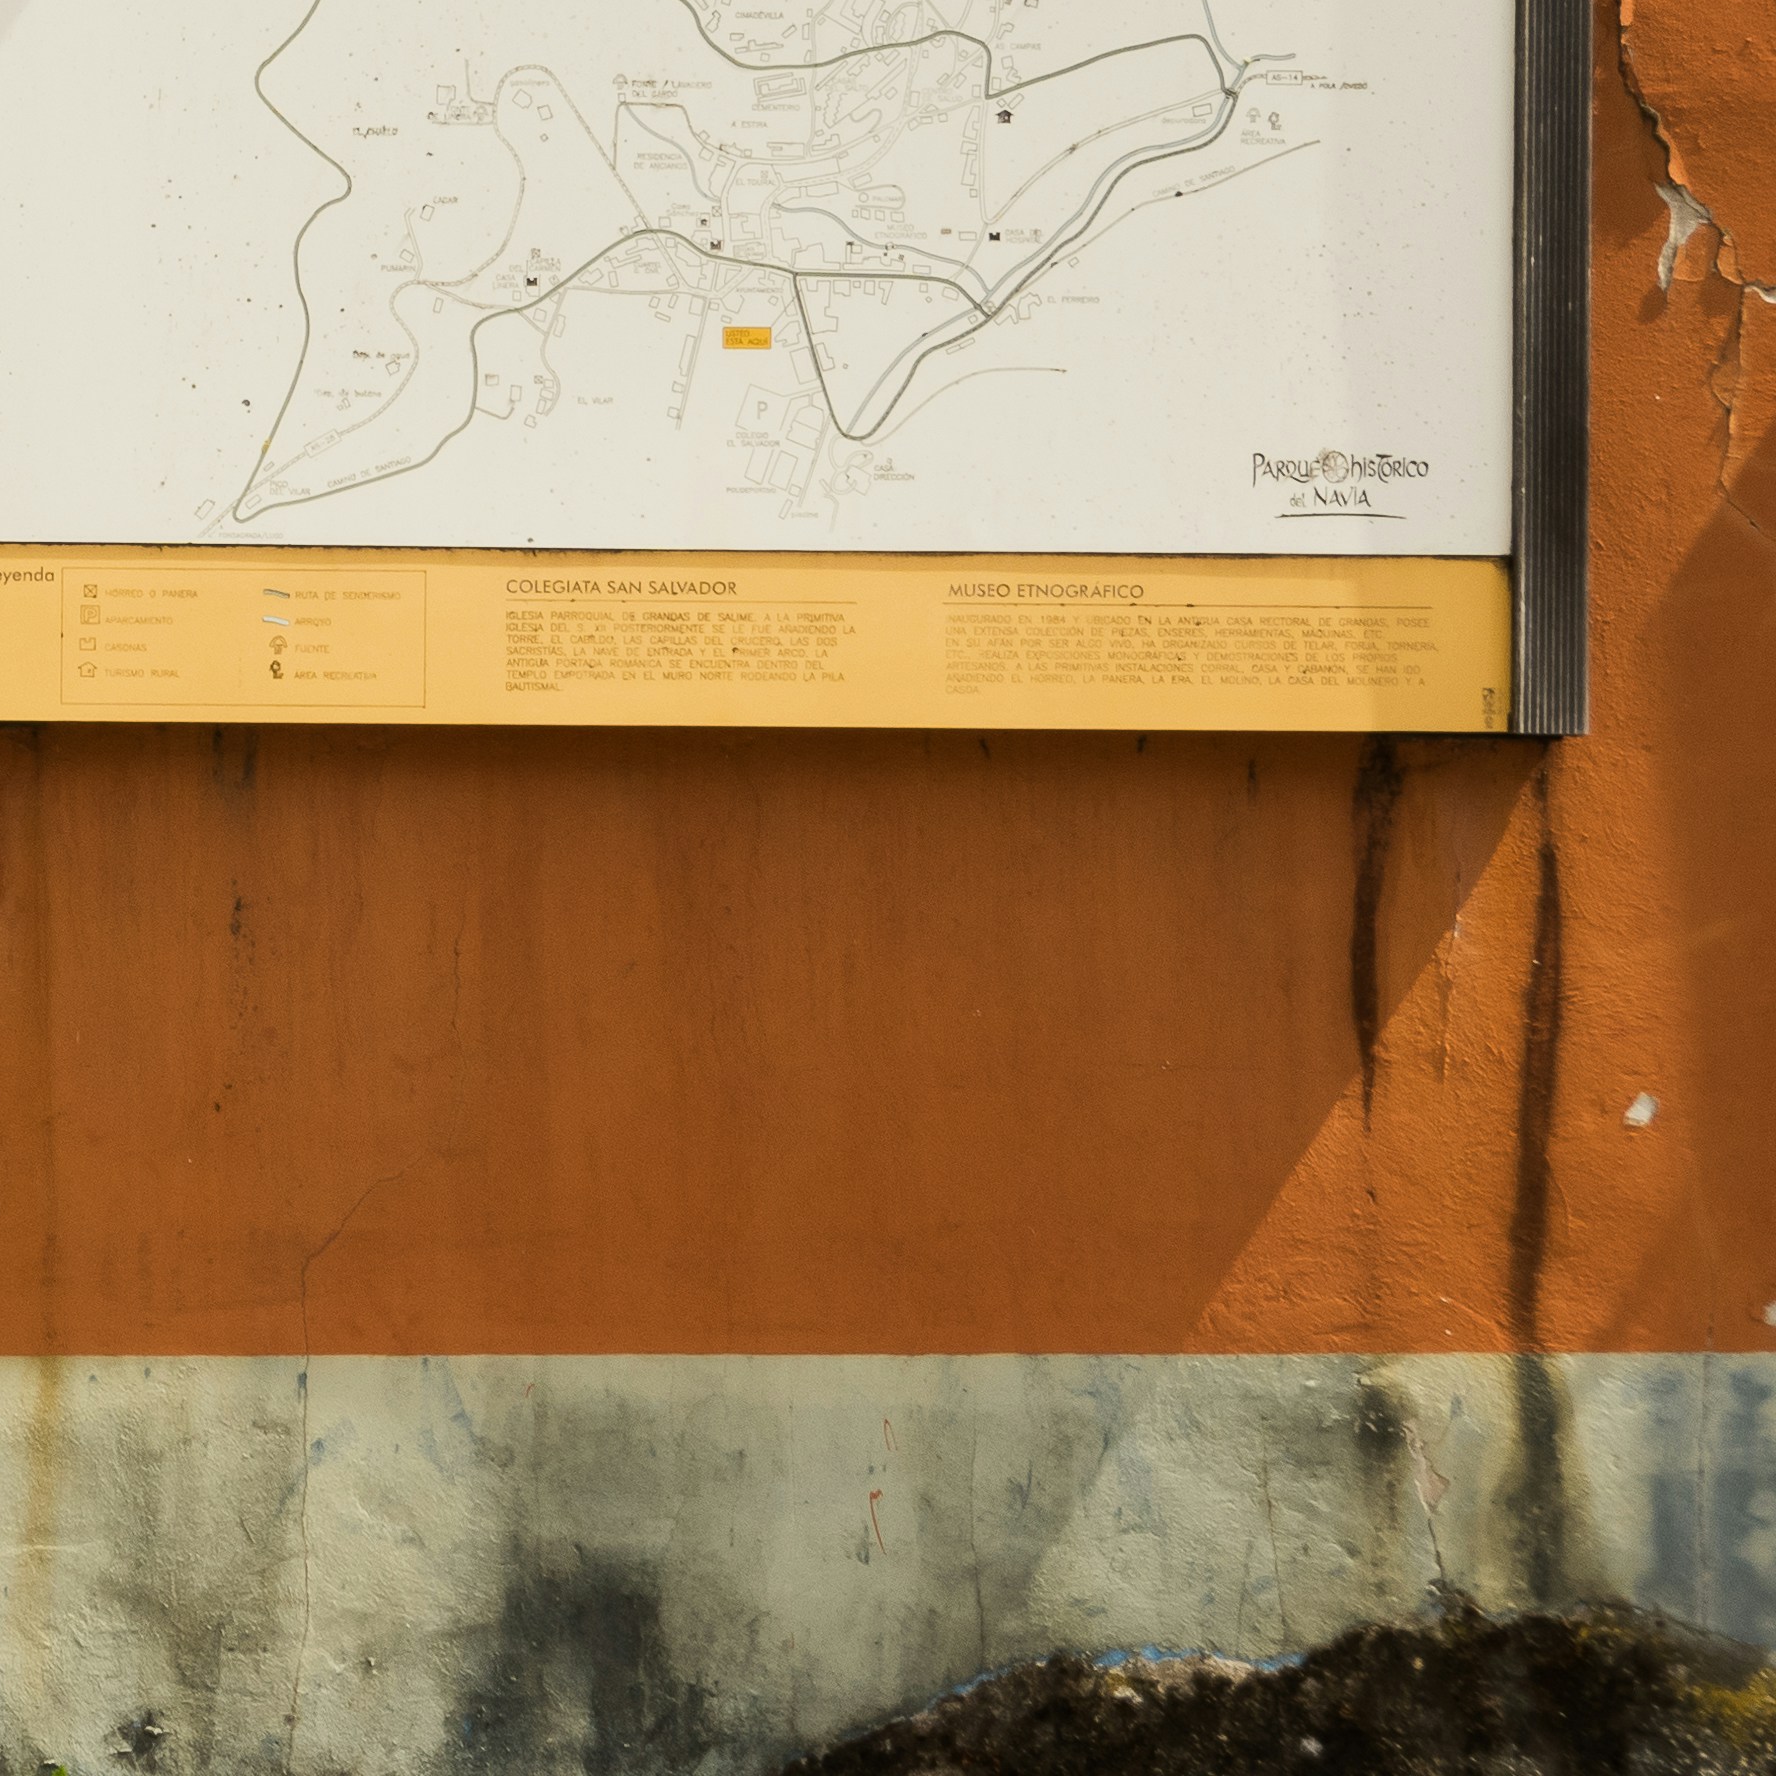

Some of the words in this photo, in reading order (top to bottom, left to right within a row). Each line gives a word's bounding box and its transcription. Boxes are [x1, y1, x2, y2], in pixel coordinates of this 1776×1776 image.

[741, 439, 781, 448] SALVADOR
[374, 455, 412, 473] SANTIAGO
[506, 579, 601, 594] COLEGIATA
[607, 580, 642, 595] SAN
[648, 580, 738, 596] SALVADOR
[948, 583, 1011, 598] MUSEO
[1017, 581, 1145, 599] ETNOGRÁFICO
[295, 591, 319, 600] RUTA
[104, 643, 148, 652] CASONAS
[294, 644, 331, 654] FUENTE
[104, 669, 145, 678] TURISMO
[151, 669, 180, 679] RURAL
